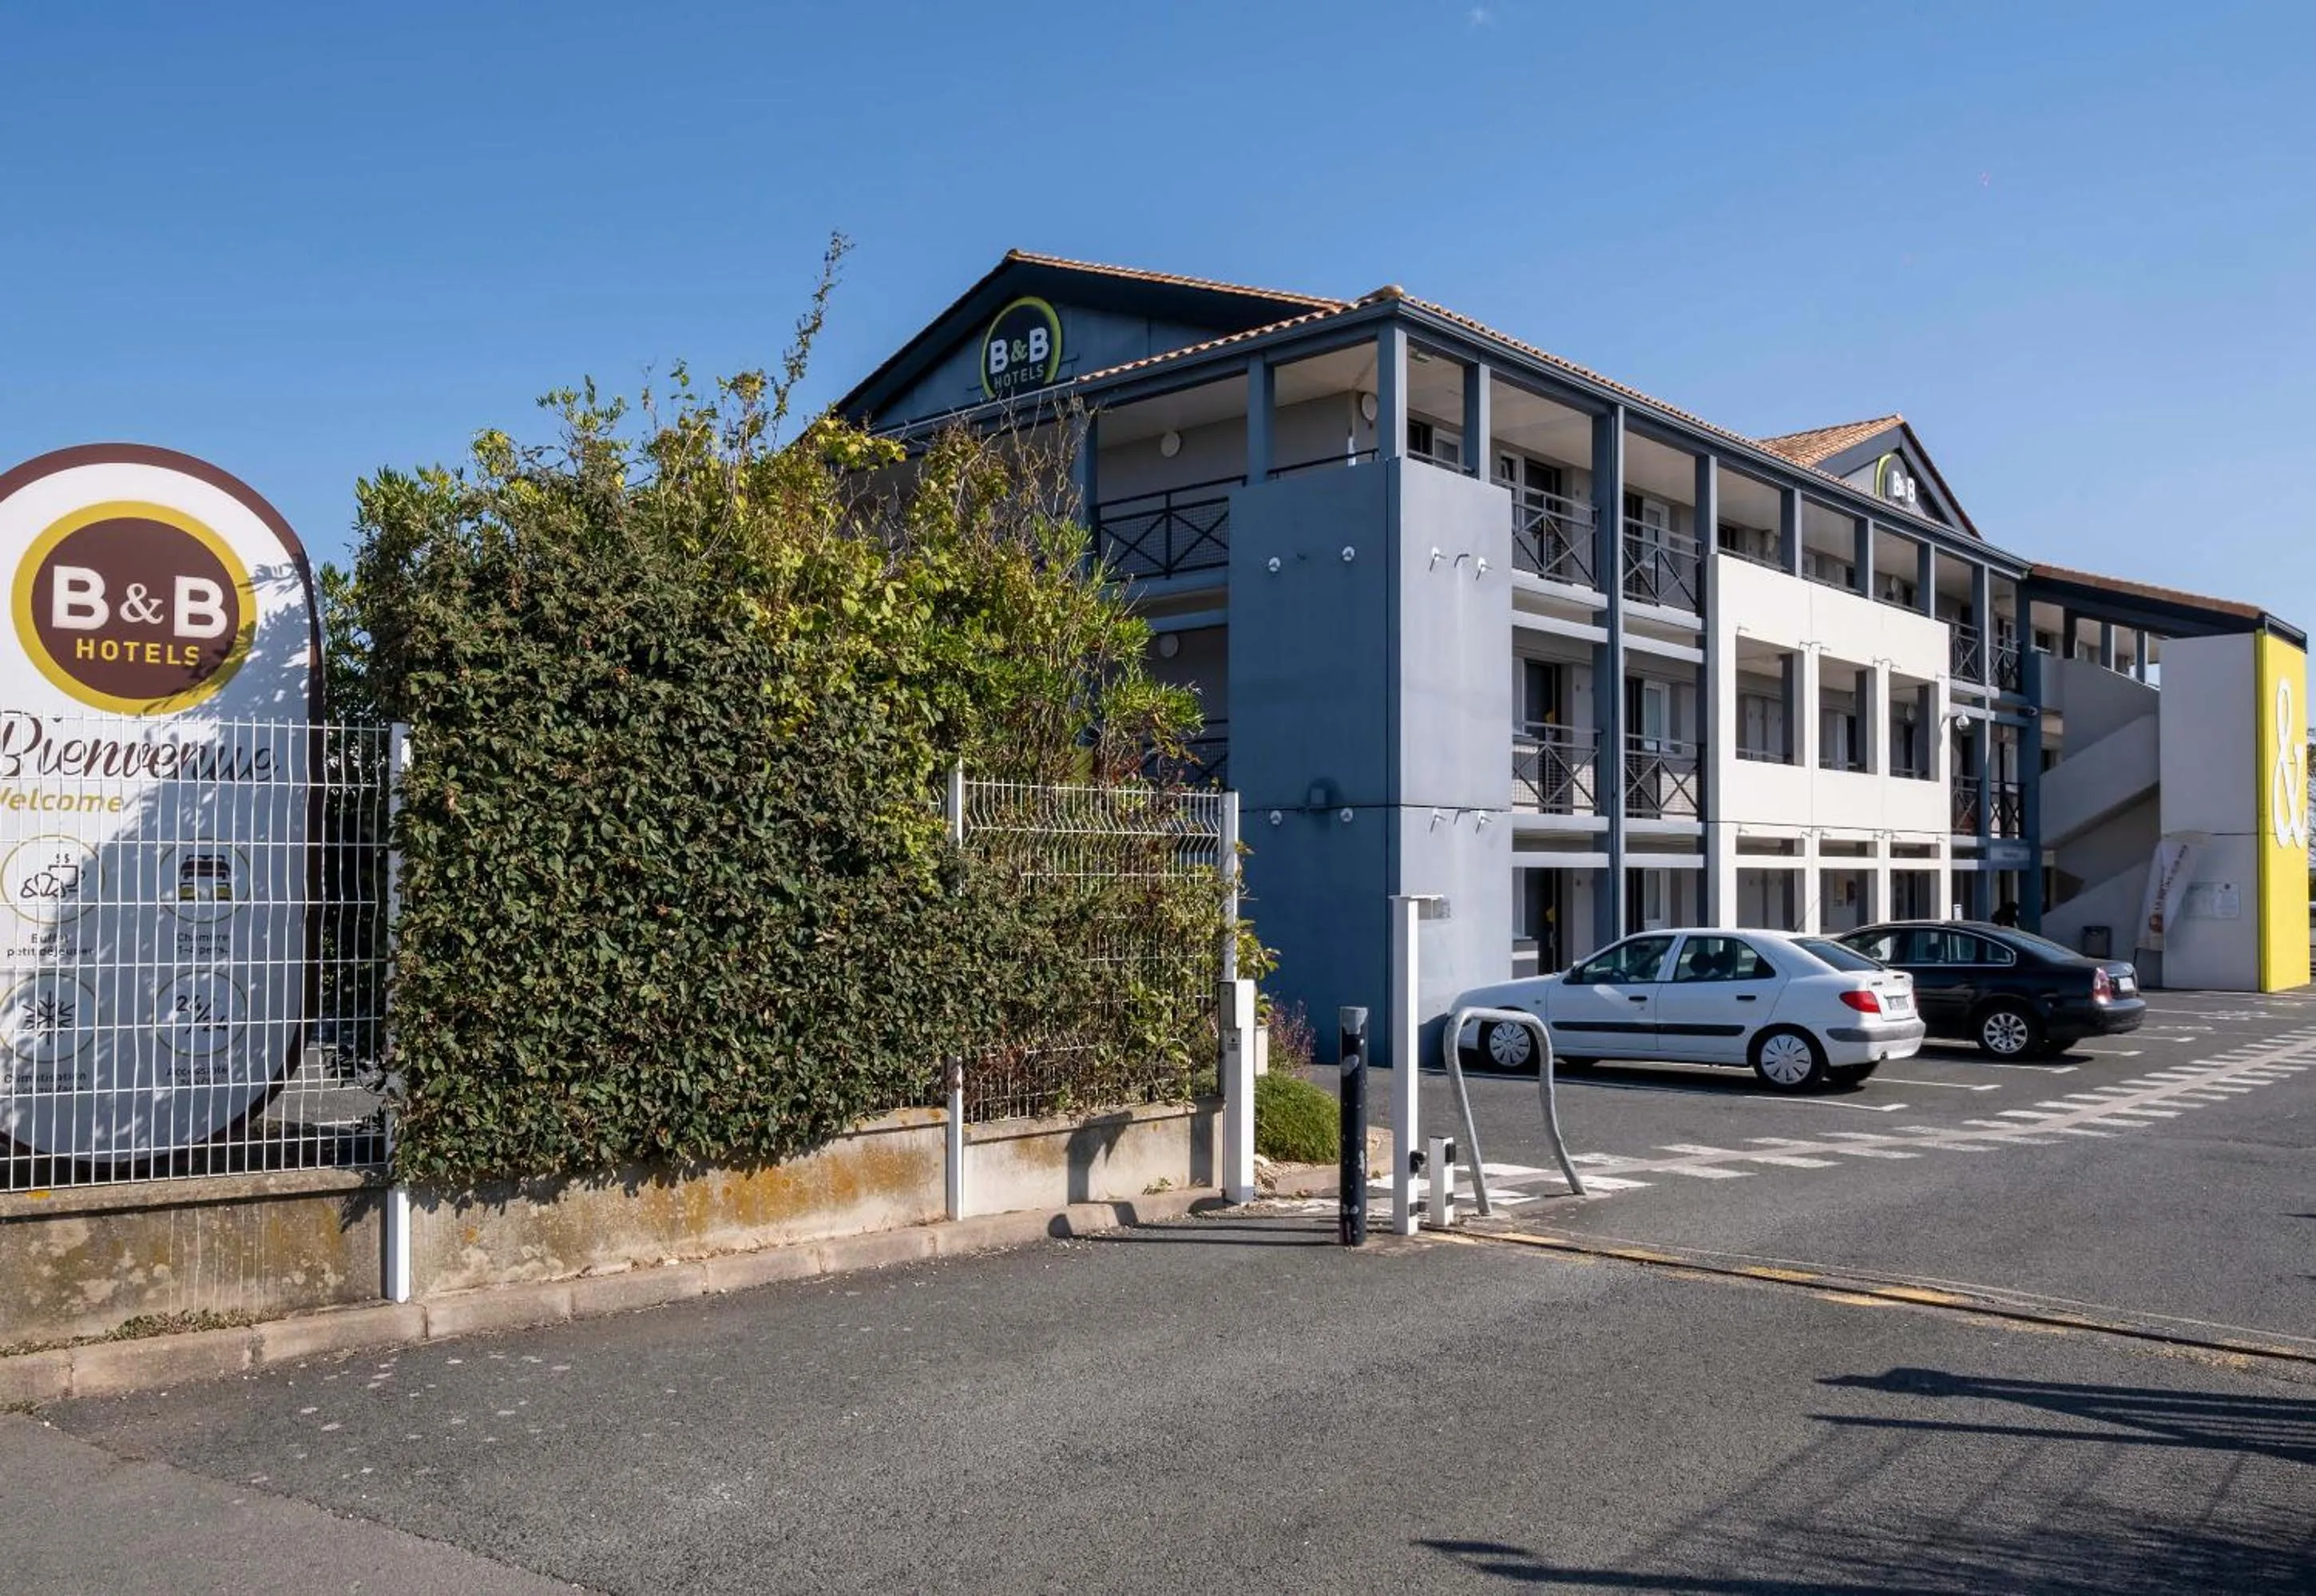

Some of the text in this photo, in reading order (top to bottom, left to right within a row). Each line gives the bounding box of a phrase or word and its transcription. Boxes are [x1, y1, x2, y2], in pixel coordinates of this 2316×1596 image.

[990, 327, 1049, 374] B&B
[993, 364, 1045, 389] HOTELS
[1893, 470, 1915, 502] B&B
[52, 565, 228, 639] B&B
[76, 638, 200, 666] HOTELS
[0, 786, 123, 813] elcome
